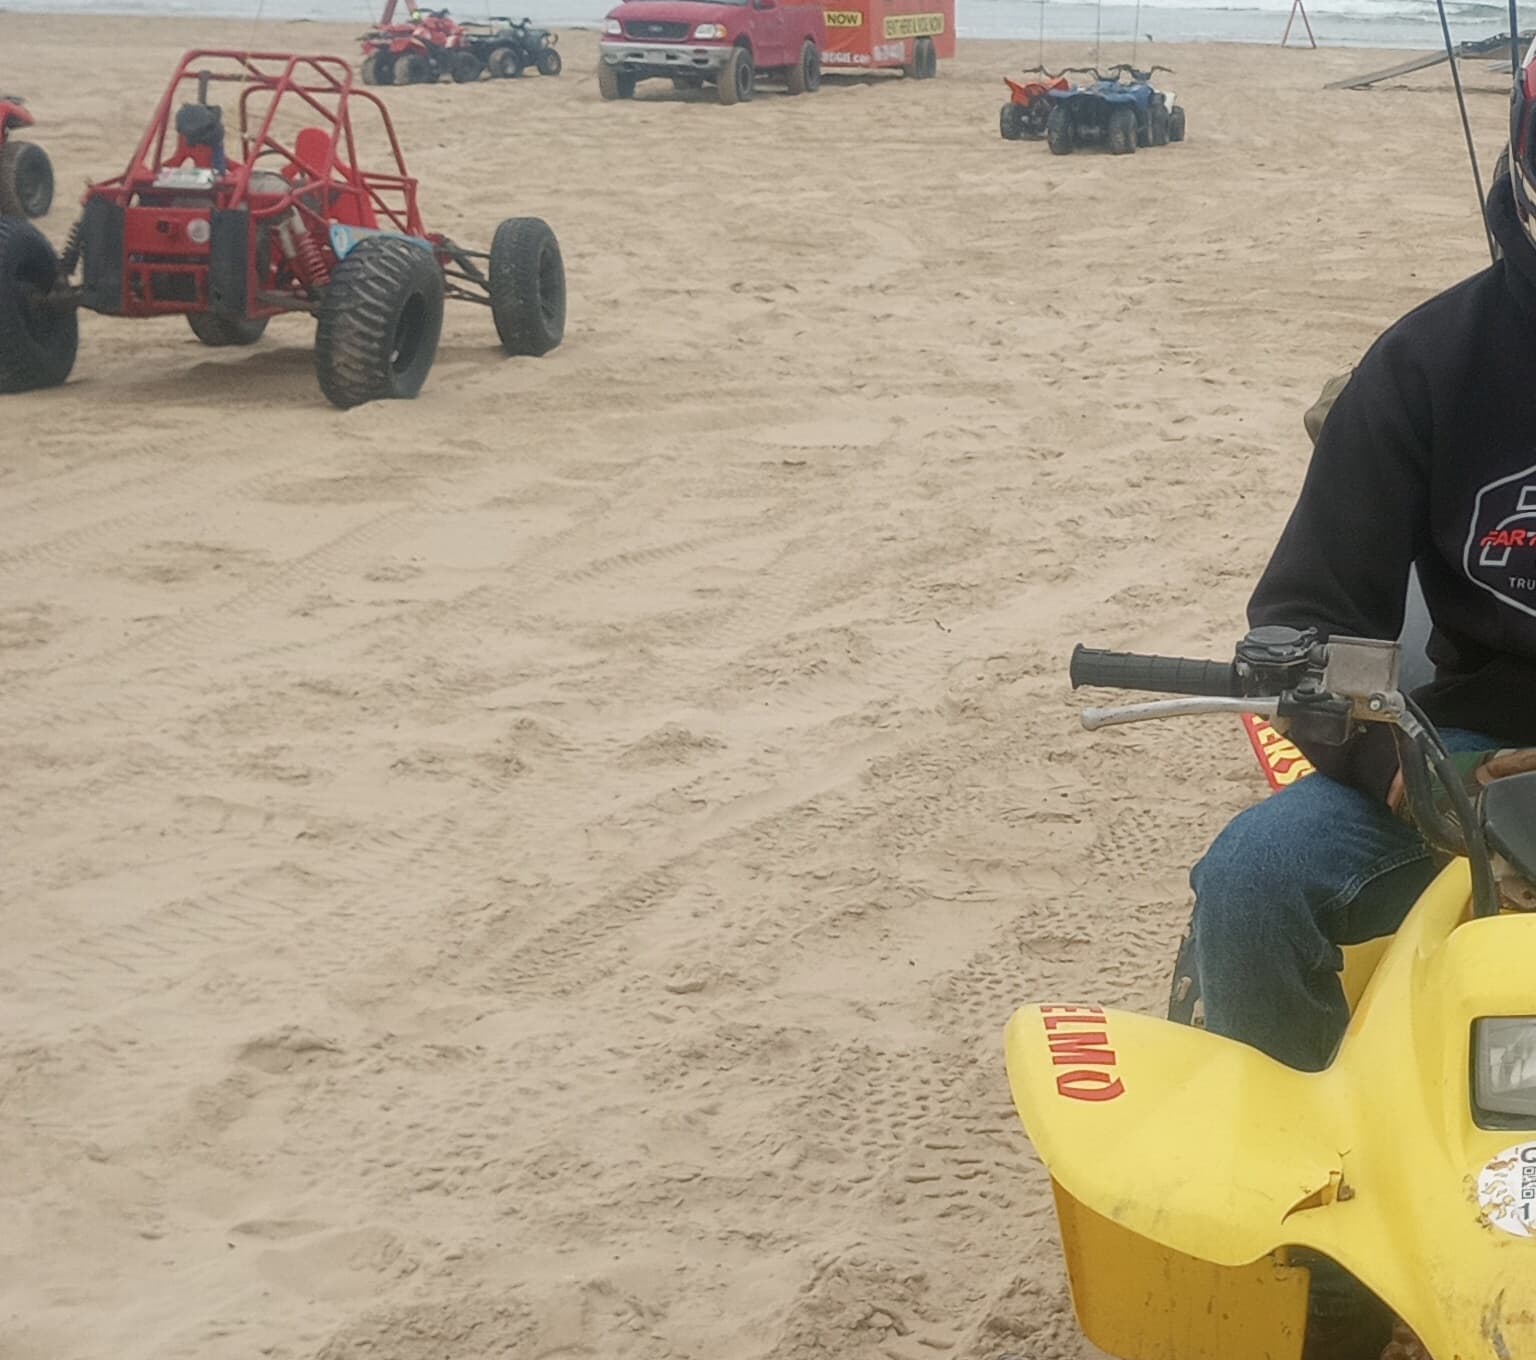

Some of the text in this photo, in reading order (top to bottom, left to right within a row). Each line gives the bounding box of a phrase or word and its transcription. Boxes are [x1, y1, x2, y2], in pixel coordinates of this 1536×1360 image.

[827, 13, 859, 25] NOW
[1480, 528, 1527, 548] FAR
[1040, 1005, 1126, 1102] ELMO
